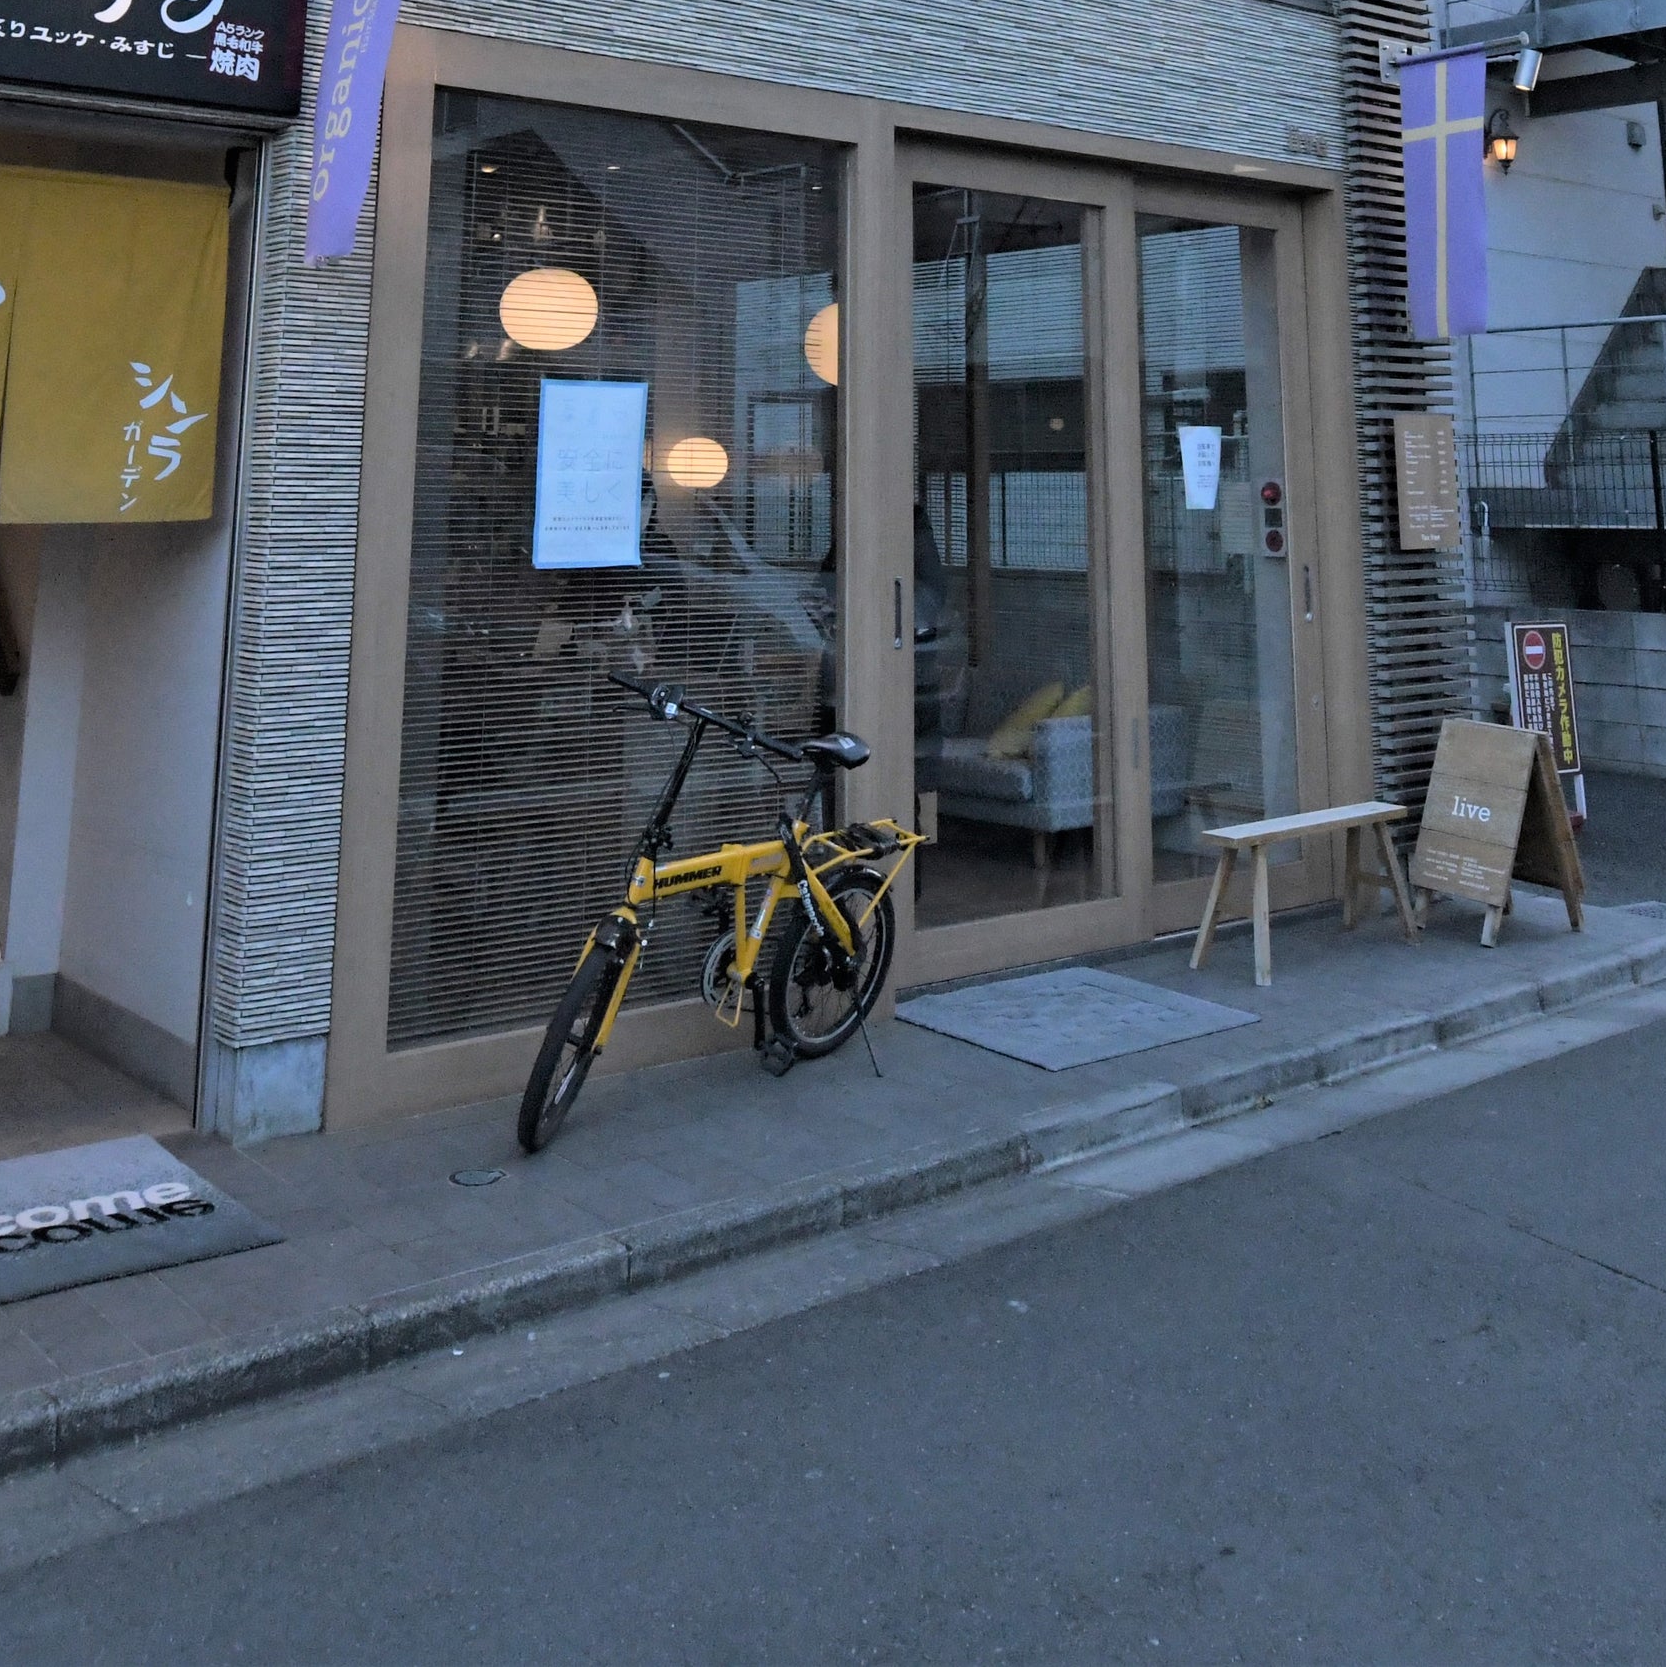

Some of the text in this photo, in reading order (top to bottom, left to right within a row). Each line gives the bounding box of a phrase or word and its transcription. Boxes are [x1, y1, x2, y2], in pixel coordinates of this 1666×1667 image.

[213, 31, 264, 55] 黒毛和牛
[215, 21, 265, 40] A5ランク
[209, 48, 260, 82] 焼肉
[130, 361, 209, 481] シンラ
[119, 420, 143, 512] ガーデン
[557, 448, 627, 472] 安全に
[557, 479, 623, 503] 美しく
[1551, 632, 1574, 765] 防犯カメラ作動中
[1451, 795, 1491, 822] live
[654, 866, 723, 890] HUMMER
